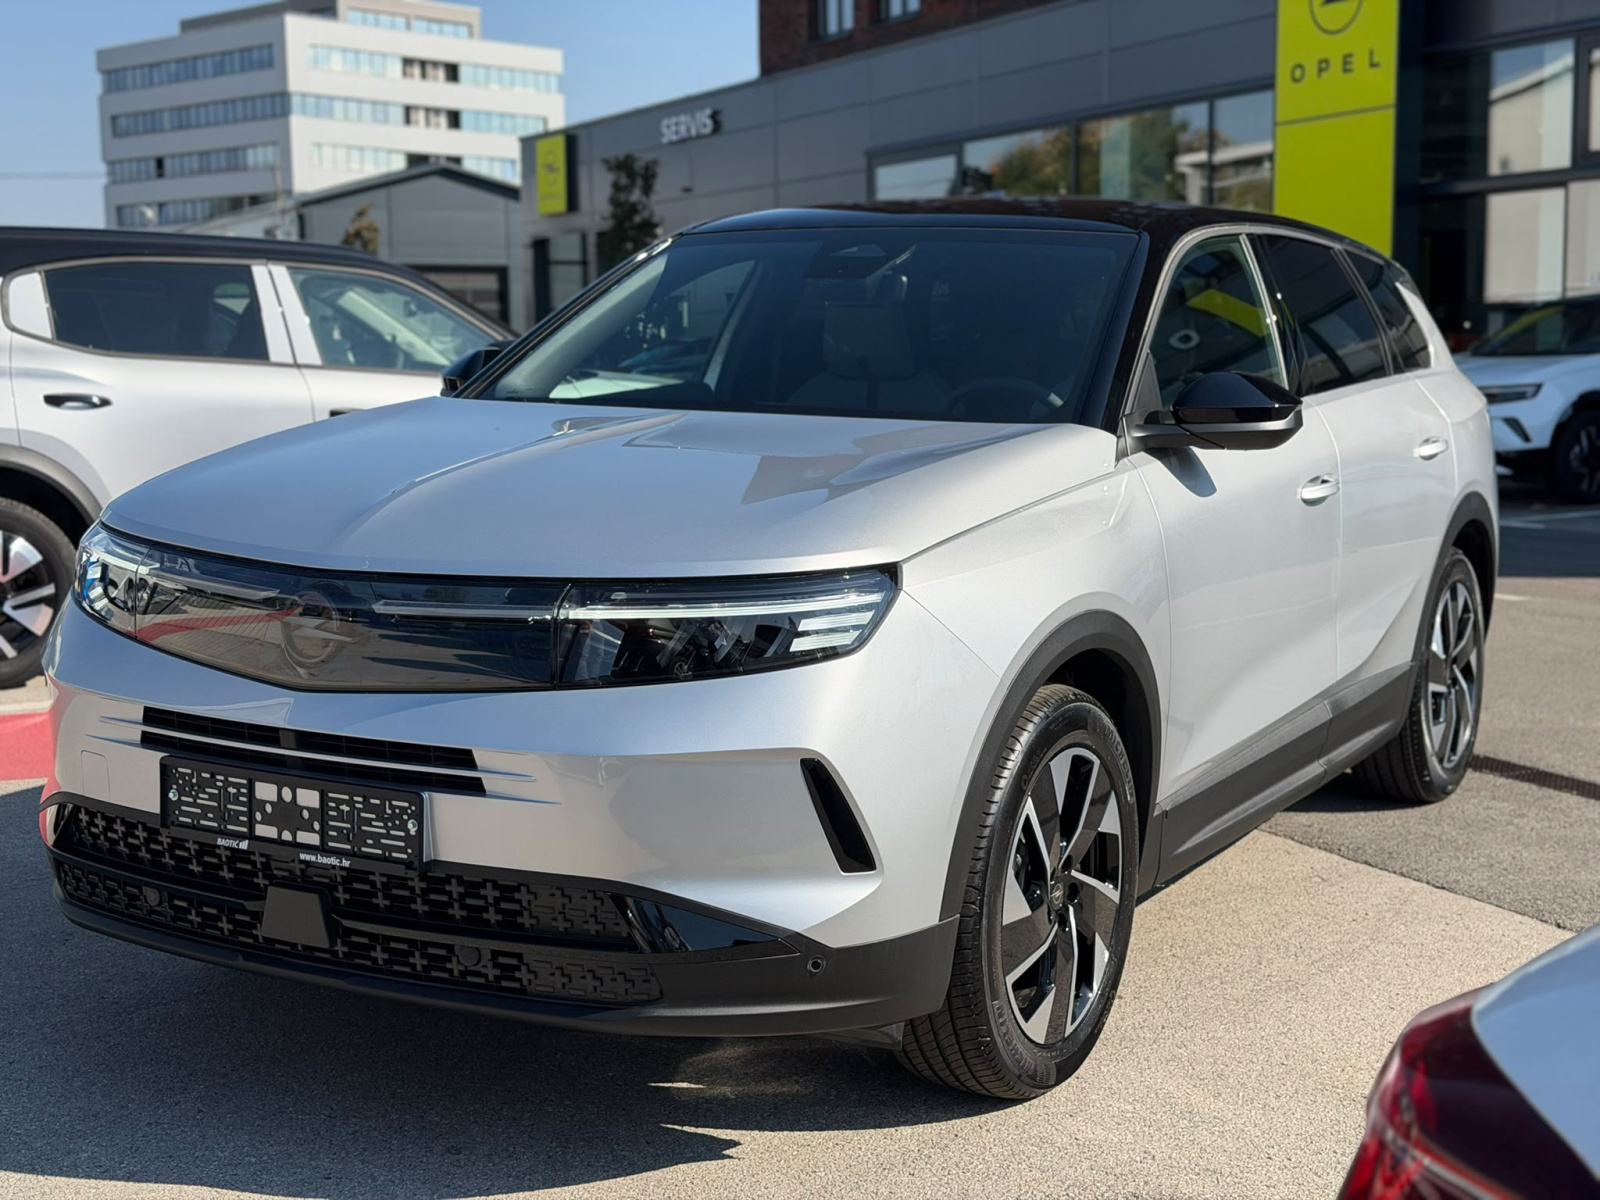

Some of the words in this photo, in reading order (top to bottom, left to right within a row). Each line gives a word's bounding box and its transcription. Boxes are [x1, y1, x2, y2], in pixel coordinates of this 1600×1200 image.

[1291, 48, 1381, 83] OPEL
[661, 107, 714, 143] SERVIS
[299, 852, 351, 867] www.baotic.hr
